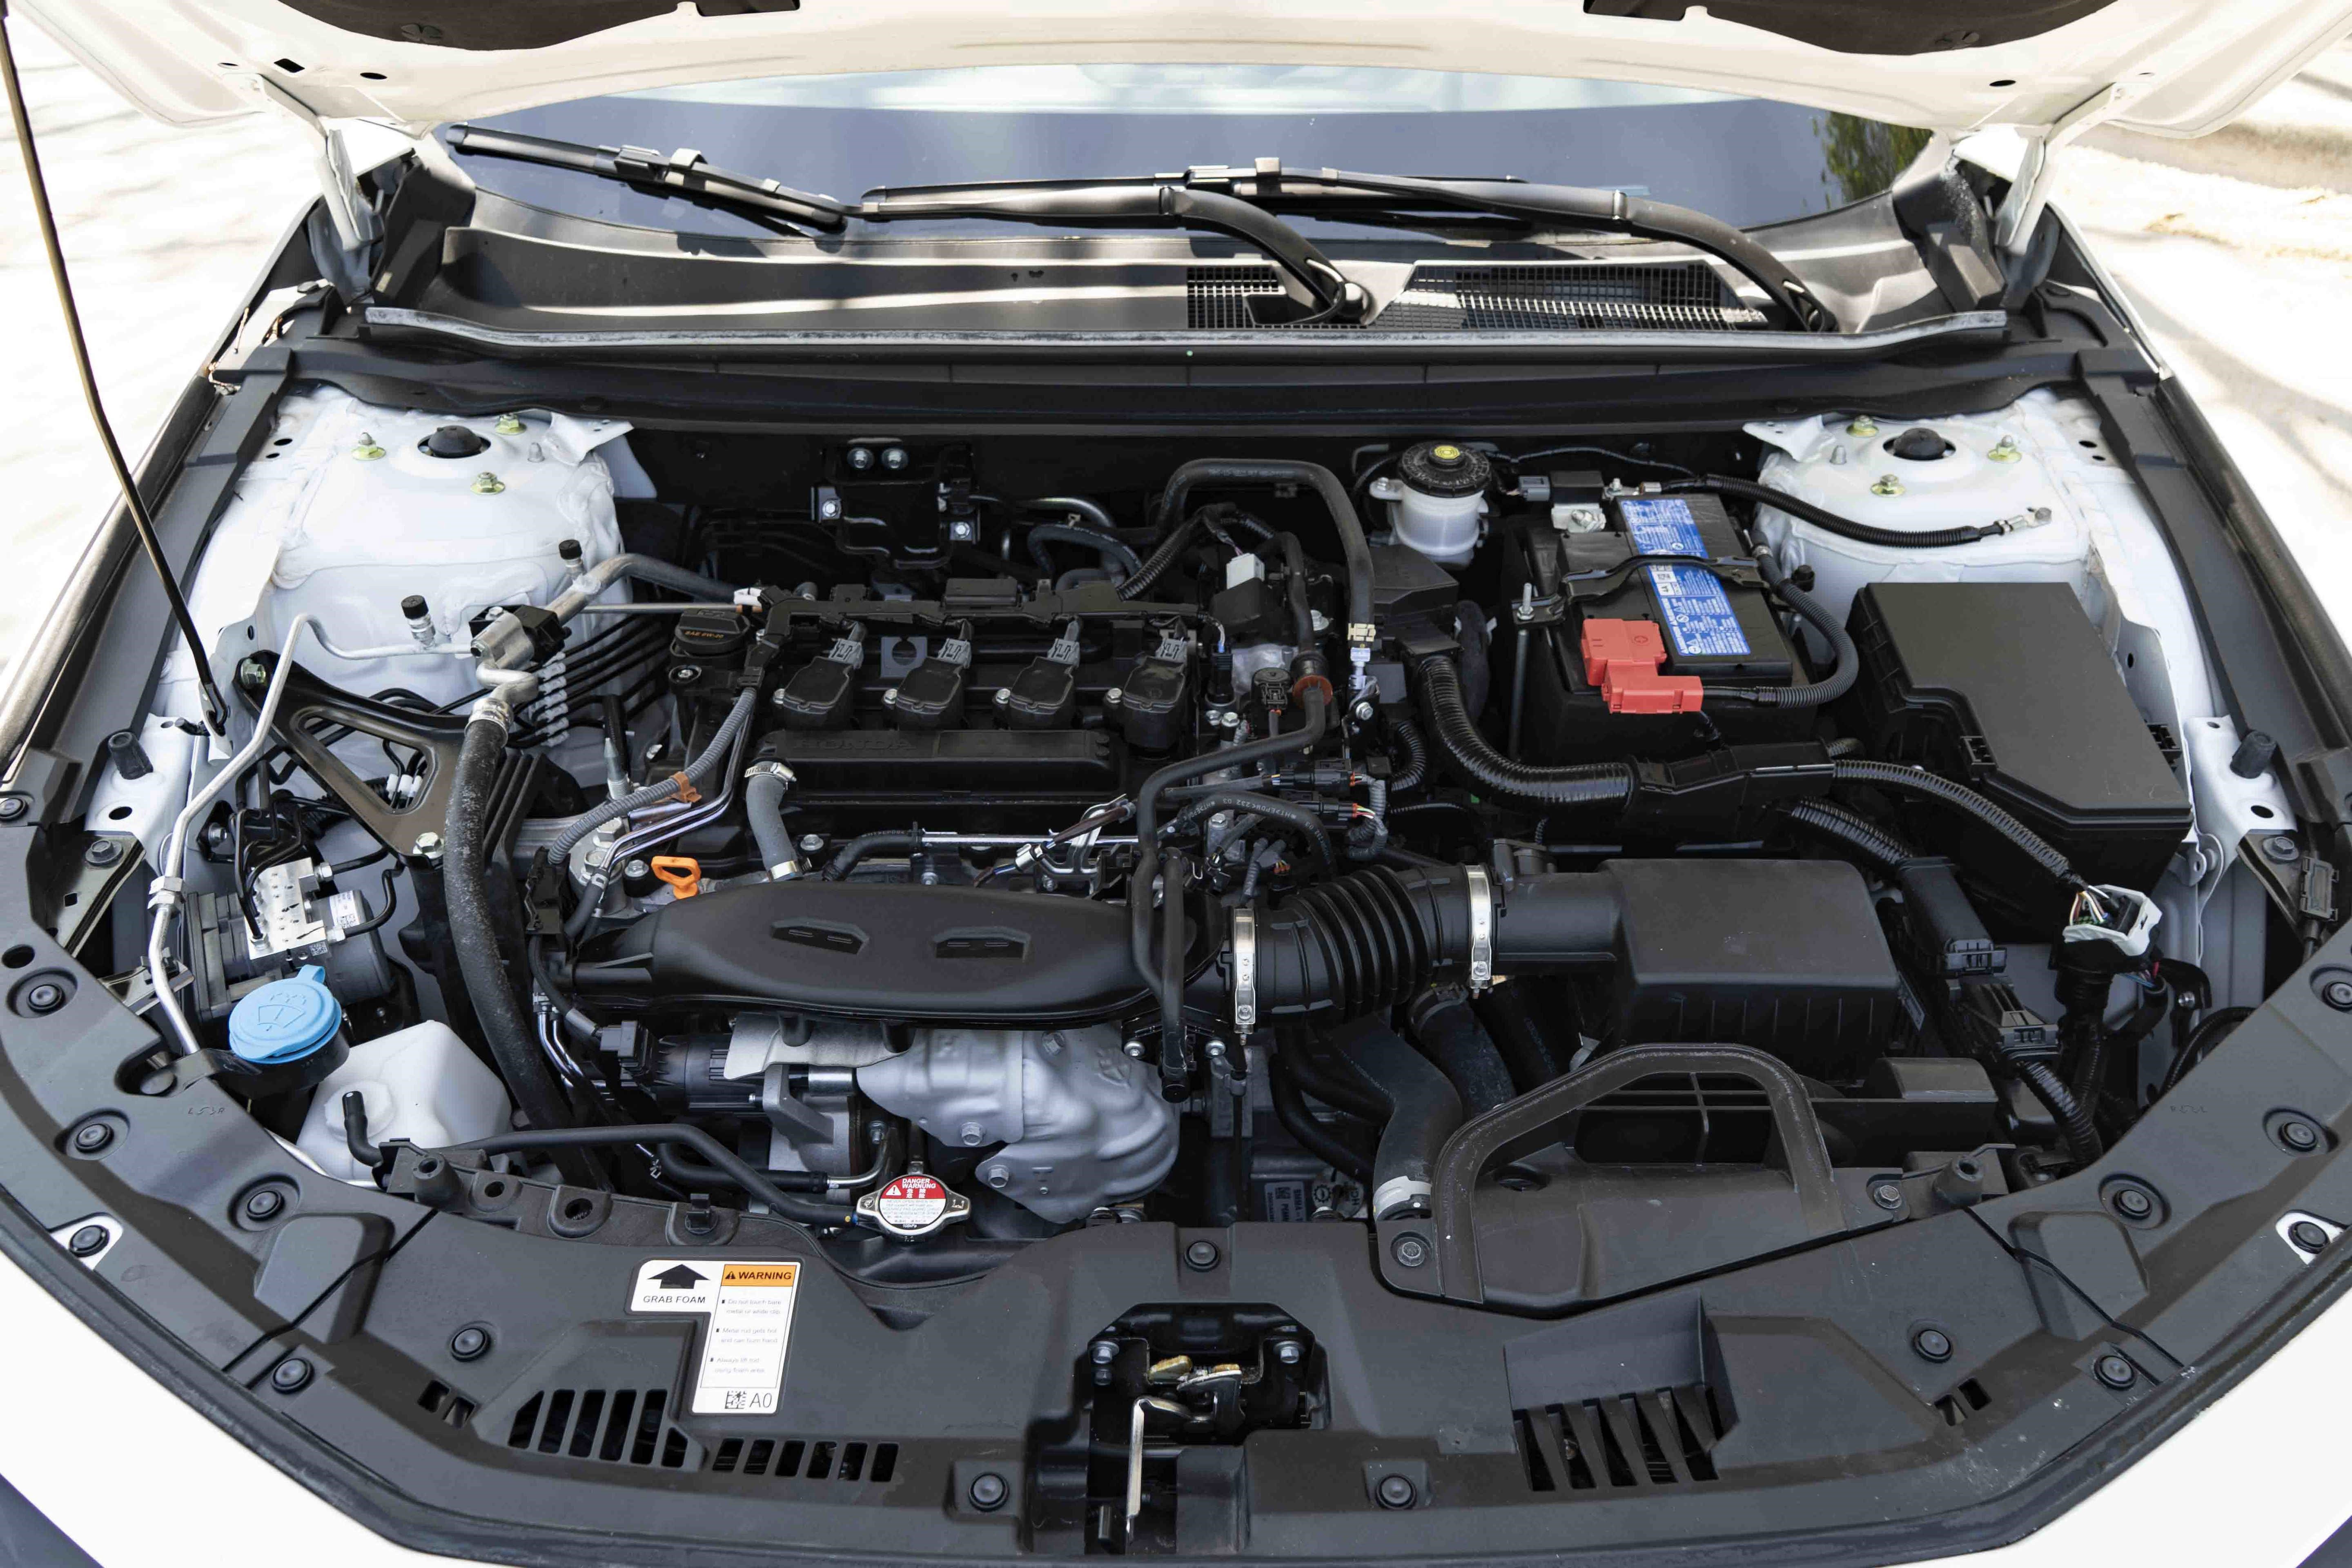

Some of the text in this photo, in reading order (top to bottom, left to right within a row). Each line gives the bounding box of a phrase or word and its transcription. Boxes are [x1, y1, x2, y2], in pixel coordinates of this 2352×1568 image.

[738, 1272, 792, 1280] WARNING
[643, 1295, 706, 1304] GRAB FOAM
[749, 1393, 772, 1408] A0
